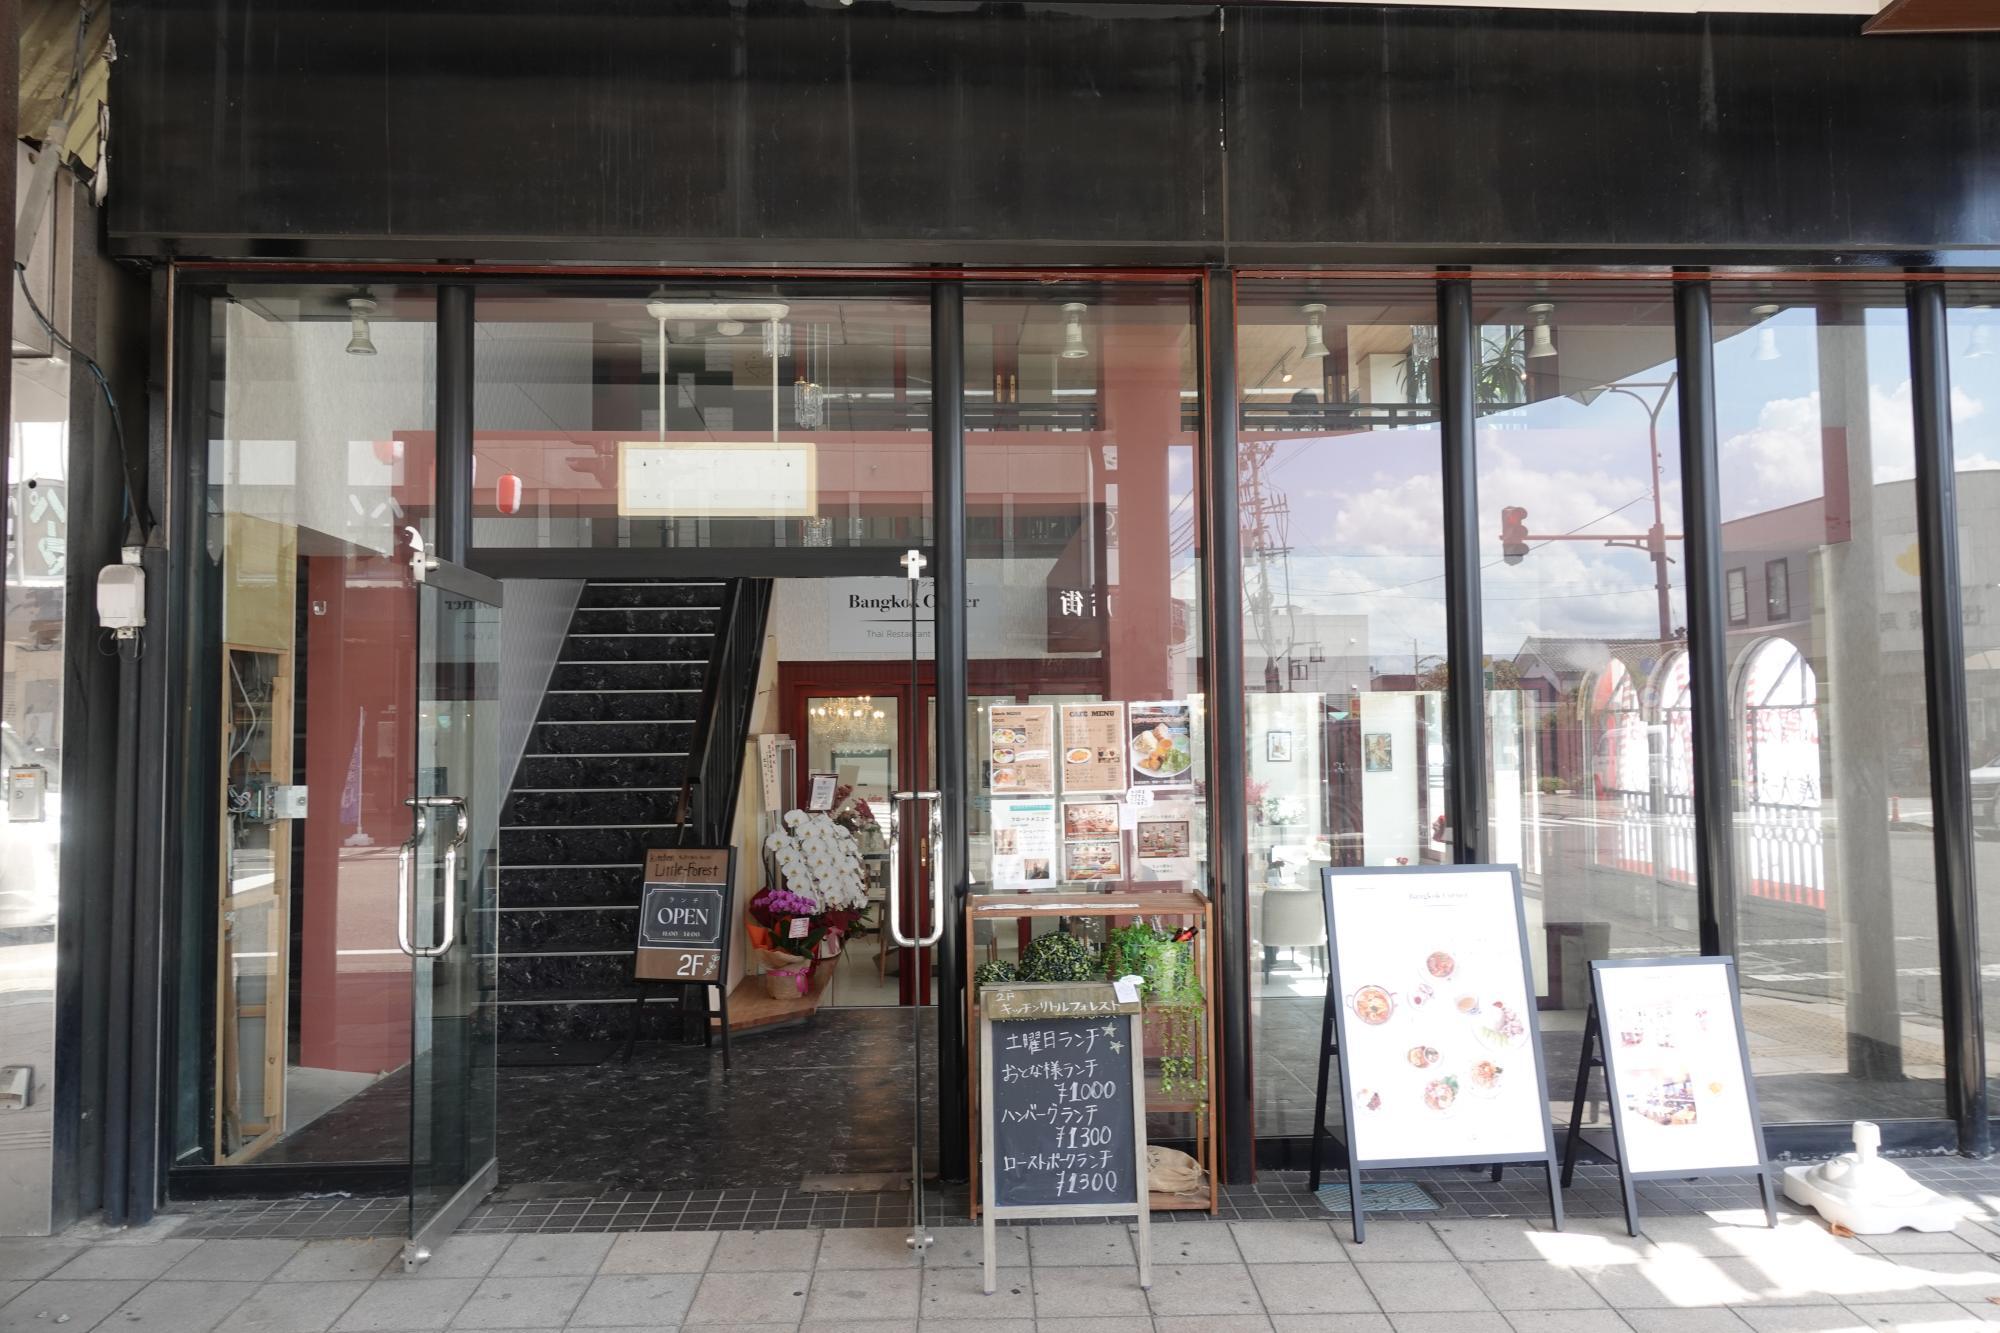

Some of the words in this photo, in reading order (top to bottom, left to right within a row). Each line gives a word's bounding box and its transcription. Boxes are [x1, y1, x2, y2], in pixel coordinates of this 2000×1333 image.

[866, 629, 885, 638] Thai
[657, 907, 710, 925] OPEN
[676, 953, 705, 977] 2F
[996, 990, 1016, 1002] 2F
[1001, 1058, 1099, 1084] おとな様ランチ
[1000, 1103, 1099, 1126] ハンバーグランチ
